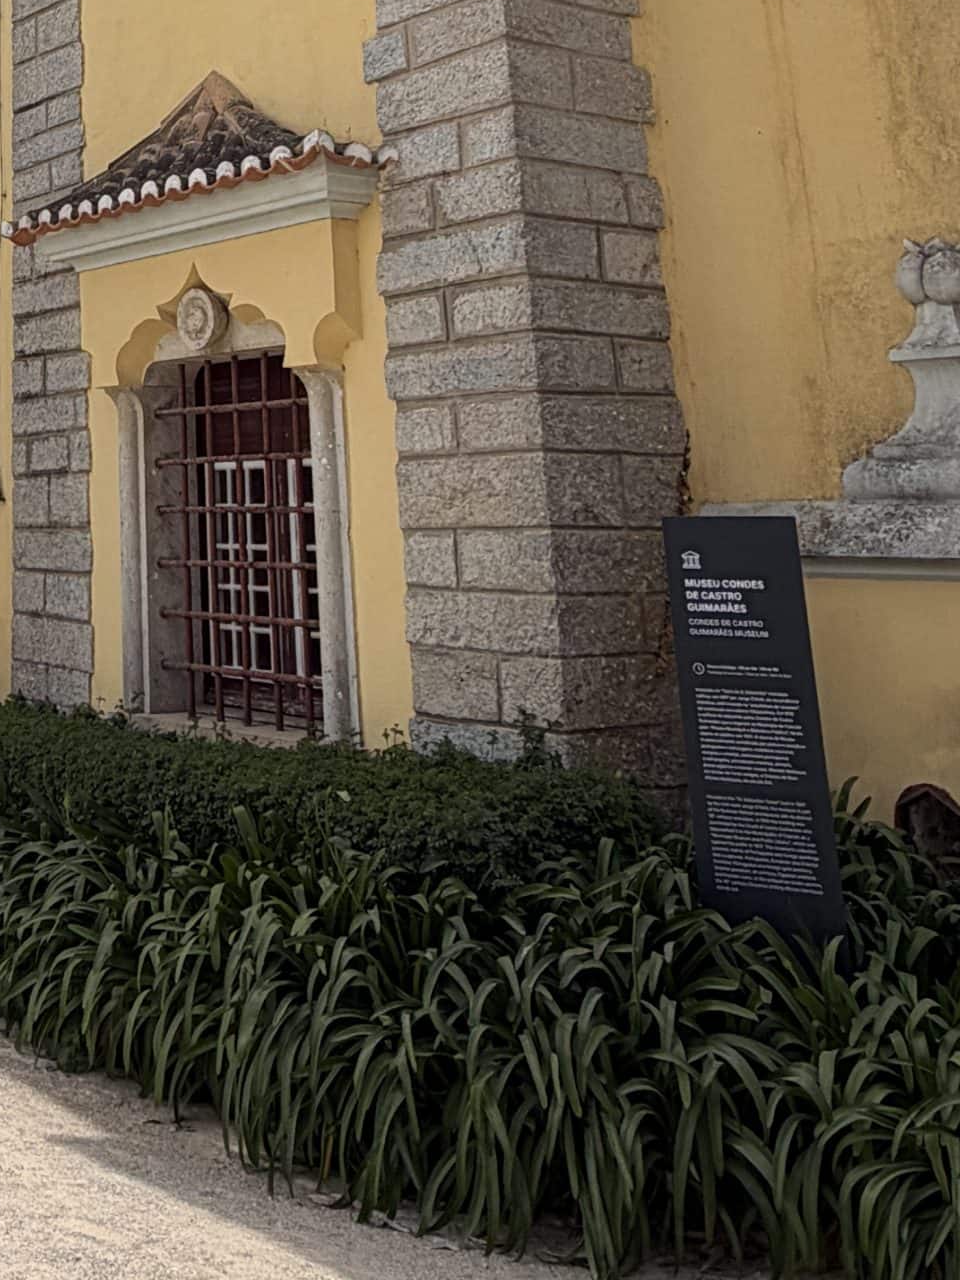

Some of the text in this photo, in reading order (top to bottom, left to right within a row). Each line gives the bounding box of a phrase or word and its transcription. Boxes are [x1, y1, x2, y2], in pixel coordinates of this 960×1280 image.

[684, 578, 765, 590] MUSEU CONDES
[685, 591, 742, 601] DE CASTRO
[687, 602, 747, 613] GUIMARÃES
[688, 618, 764, 628] CONDES DE CASTRO
[734, 630, 769, 638] MUSEUM
